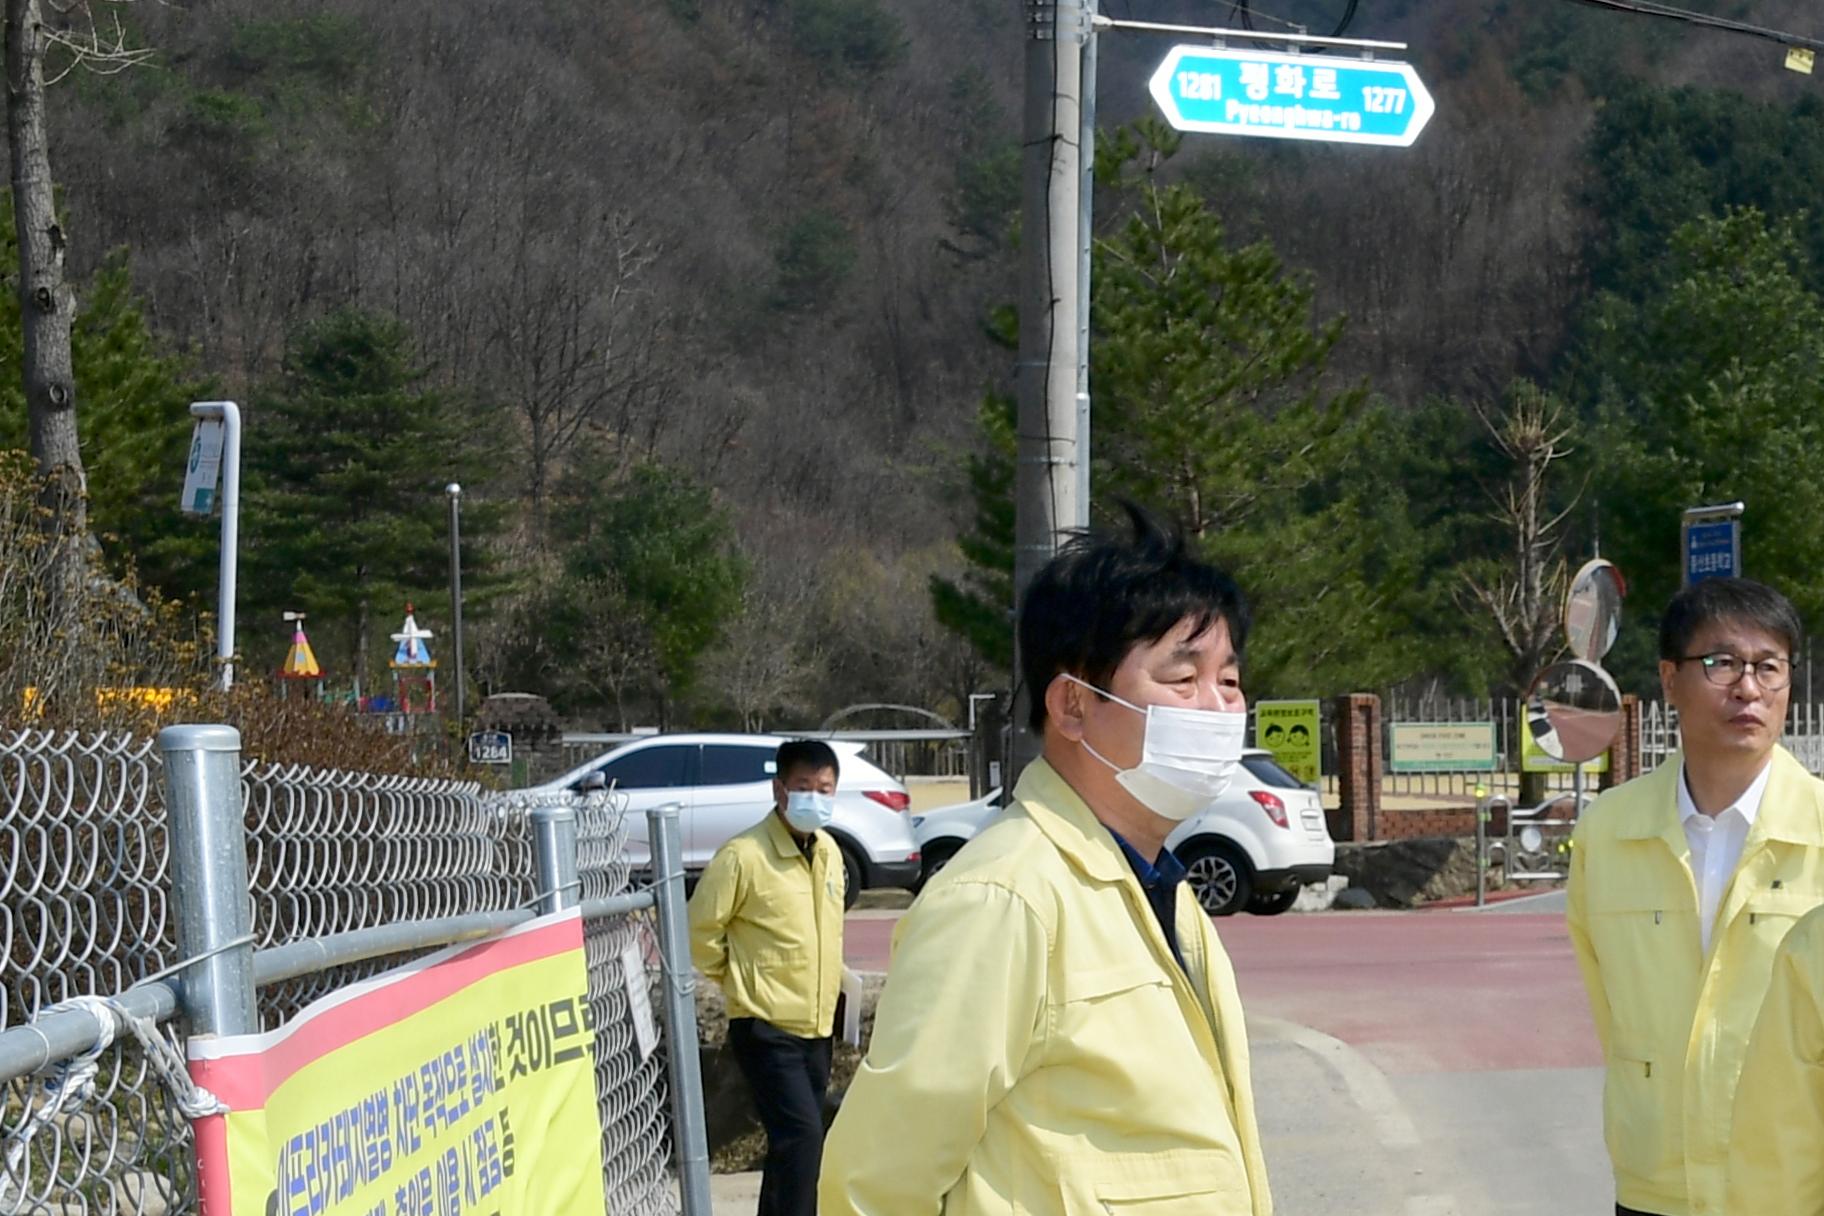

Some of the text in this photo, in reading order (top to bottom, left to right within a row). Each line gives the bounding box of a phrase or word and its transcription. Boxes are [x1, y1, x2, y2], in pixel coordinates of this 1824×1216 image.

[1240, 63, 1341, 100] 평화로
[1226, 101, 1361, 131] Pyeonghwa-ro
[1363, 87, 1407, 115] 1277
[393, 1071, 421, 1160] 차단
[420, 1043, 470, 1138] 목적으로
